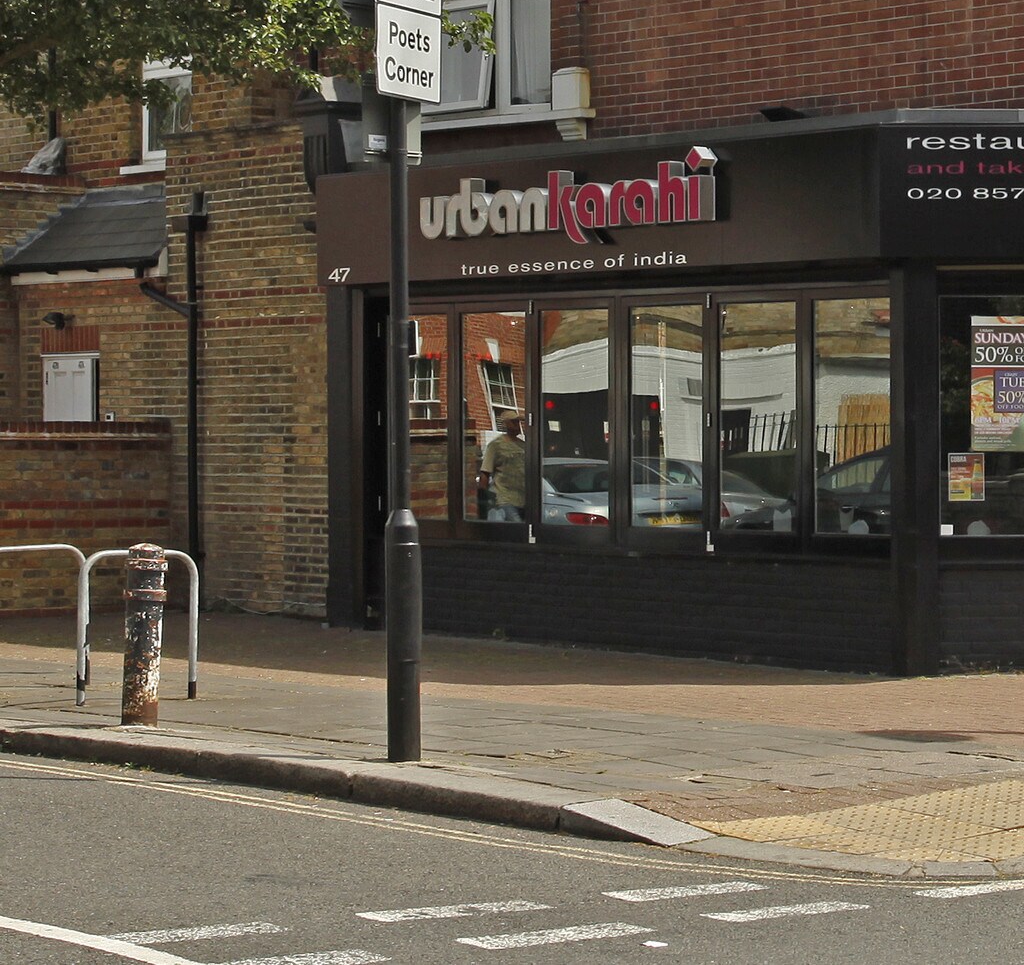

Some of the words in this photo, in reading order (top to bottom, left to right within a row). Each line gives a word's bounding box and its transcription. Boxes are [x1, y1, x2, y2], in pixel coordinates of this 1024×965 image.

[389, 21, 430, 53] Poets
[385, 56, 434, 89] Corner
[907, 161, 964, 175] and
[907, 187, 962, 200] 020
[461, 263, 500, 276] true
[508, 258, 594, 274] essence
[604, 253, 624, 269] of
[633, 251, 688, 266] india
[328, 267, 351, 283] 47
[974, 346, 1013, 362] 50%
